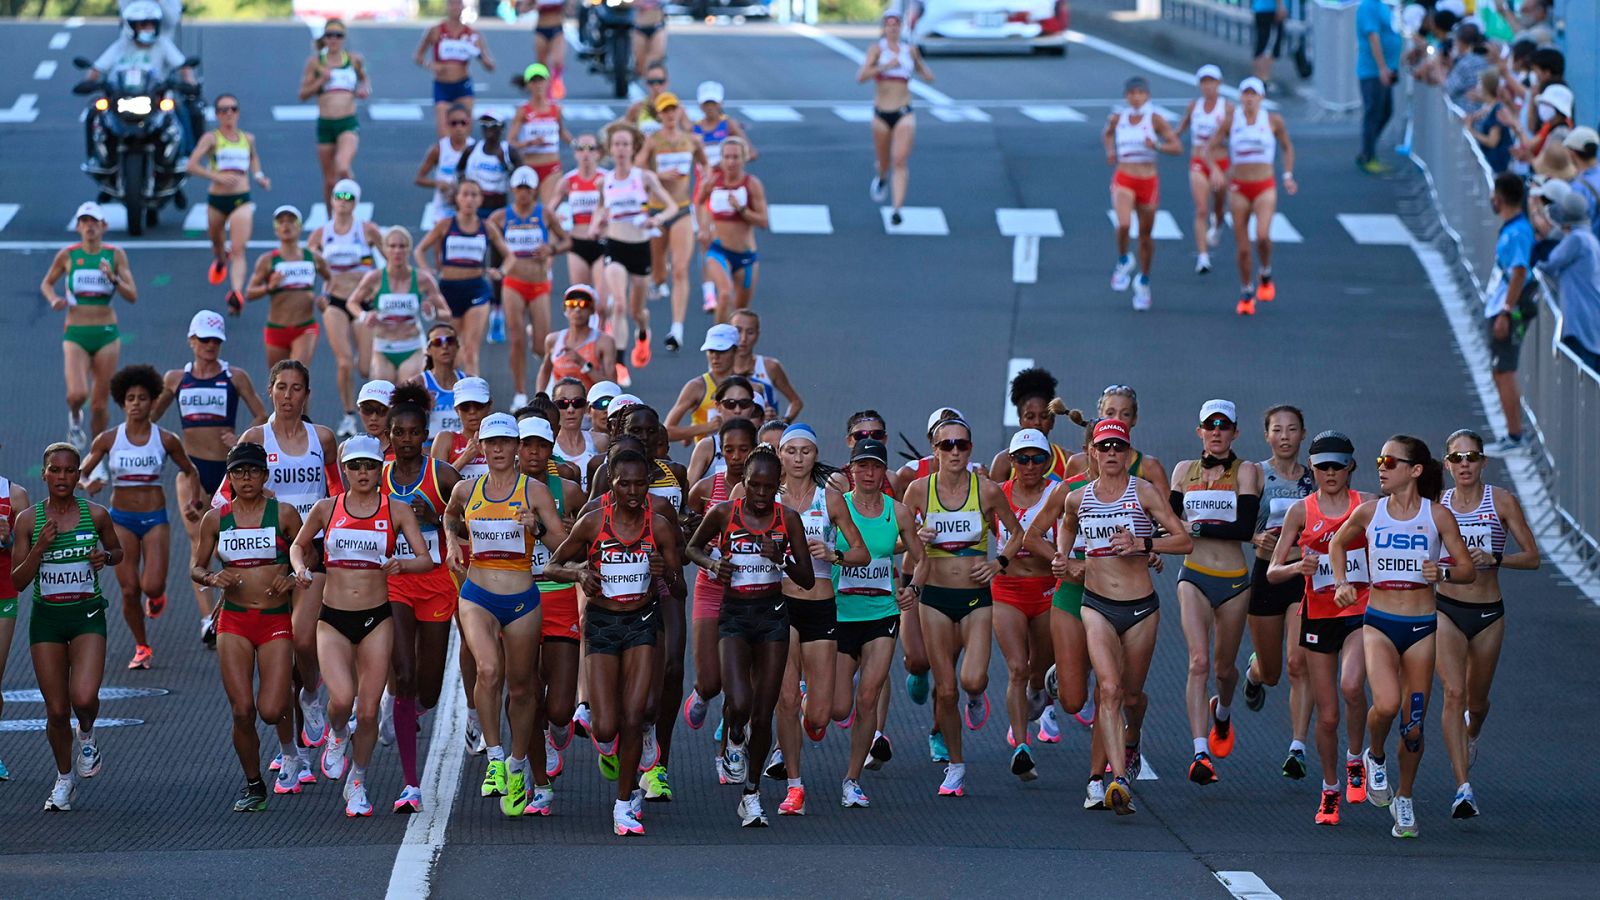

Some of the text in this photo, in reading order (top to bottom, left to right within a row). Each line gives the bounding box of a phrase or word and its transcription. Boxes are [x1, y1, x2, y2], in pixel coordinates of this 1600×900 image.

[181, 395, 225, 406] BJELJAC
[1098, 424, 1125, 434] CANADA
[120, 456, 159, 468] TIYOURI
[274, 466, 322, 484] SUISSE
[1185, 499, 1234, 511] STEINRUCK
[935, 520, 971, 533] DIVER
[472, 529, 521, 541] PROKOFYEVA
[223, 536, 272, 551] TORRES
[335, 538, 378, 551] ICHIYAMA
[731, 541, 762, 553] KEN
[1375, 533, 1428, 551] USA
[601, 550, 649, 564] KENYA
[1376, 558, 1422, 572] SEIDEL
[41, 570, 94, 585] KHATALA
[840, 566, 890, 580] MASLOVA
